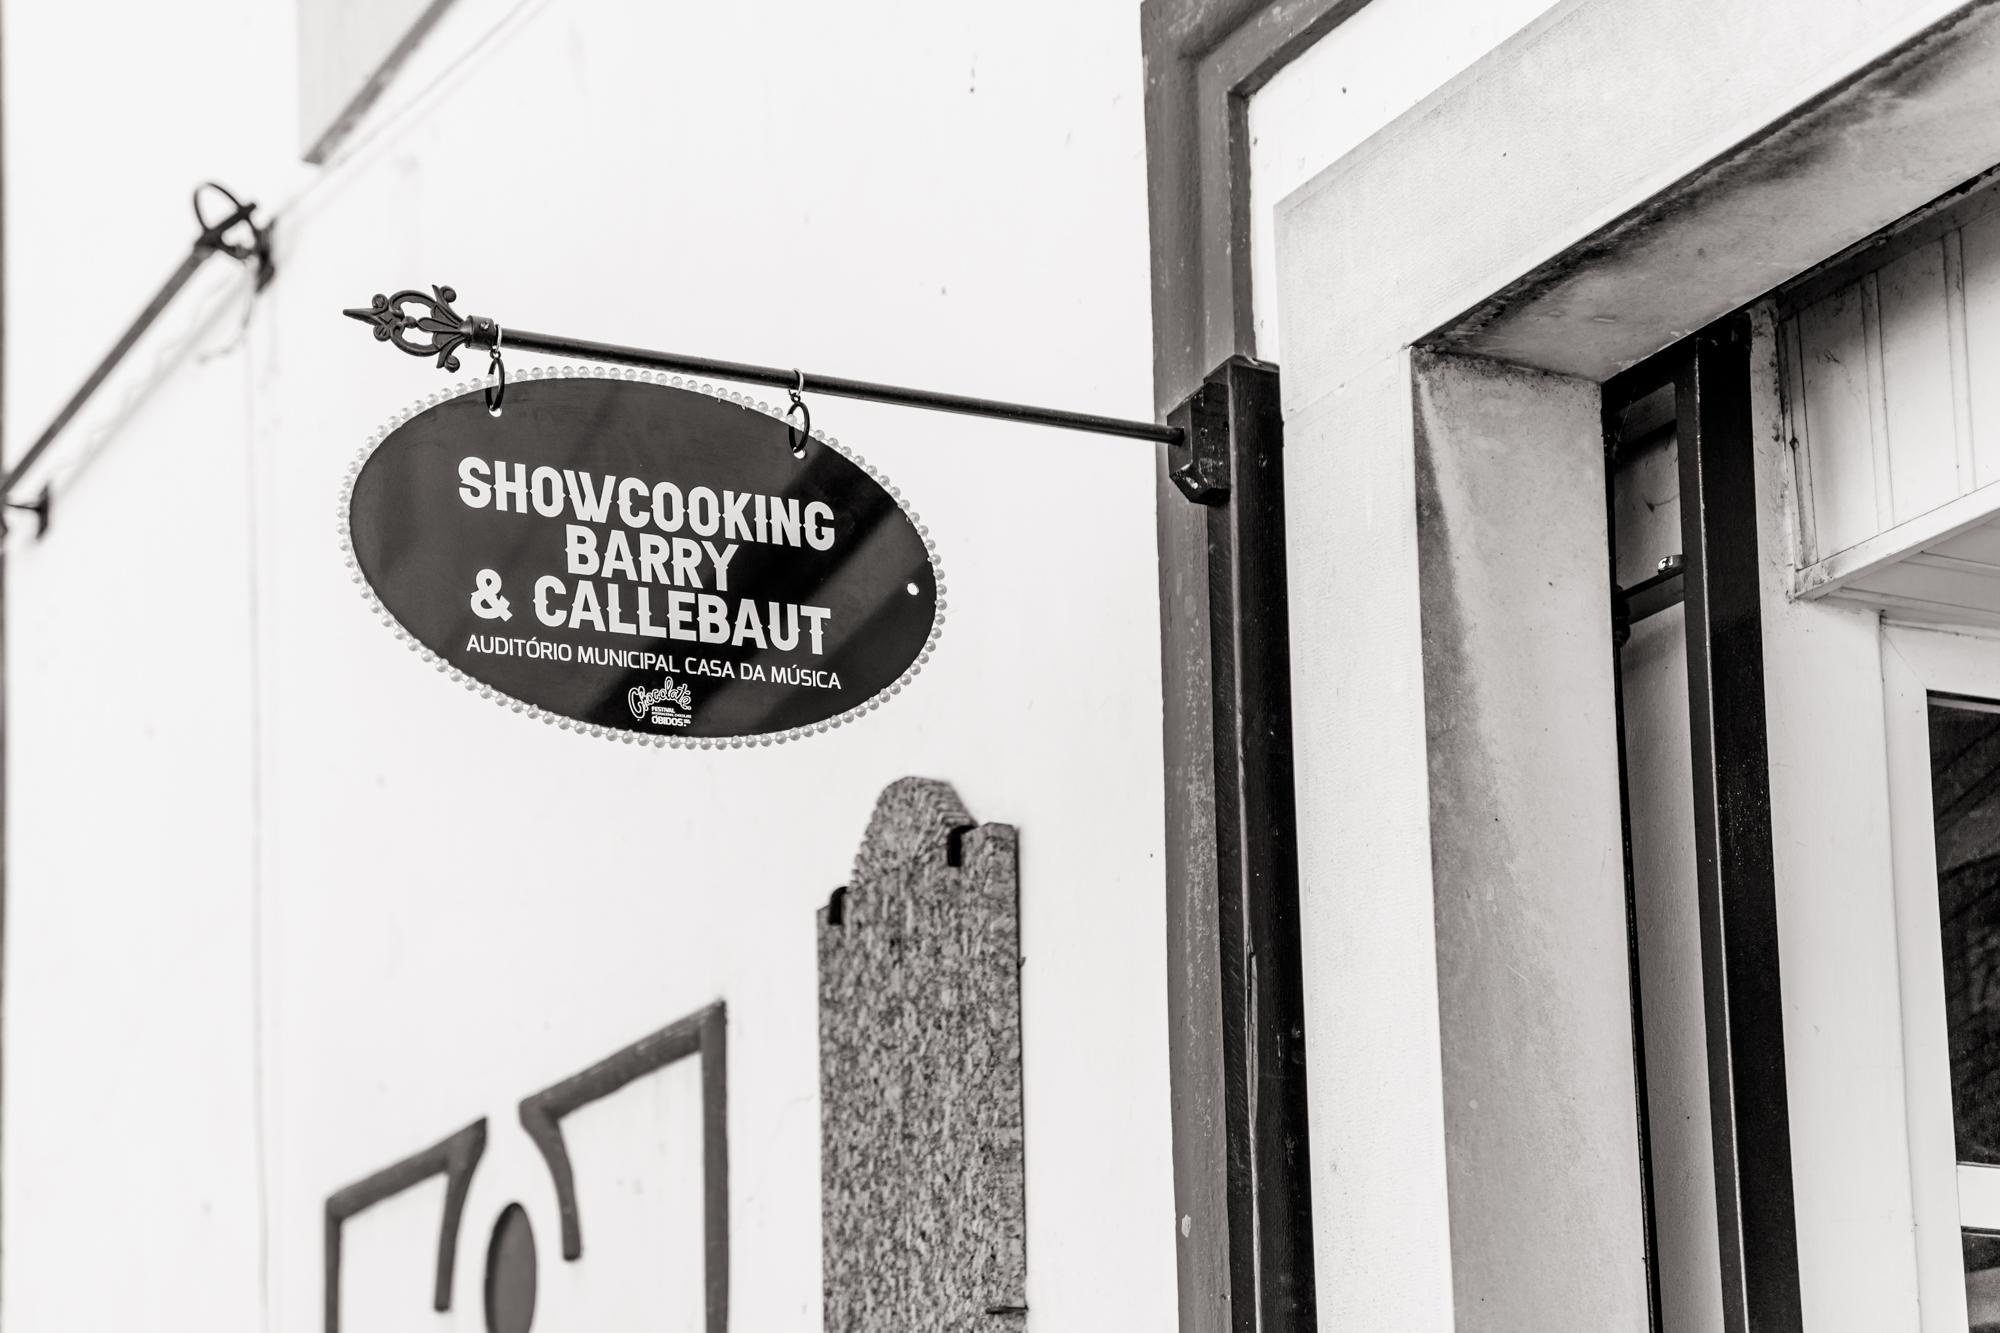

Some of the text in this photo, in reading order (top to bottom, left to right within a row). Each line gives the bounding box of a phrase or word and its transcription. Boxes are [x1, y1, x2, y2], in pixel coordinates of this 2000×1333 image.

[457, 456, 835, 551] SHOWCOOKING
[564, 523, 740, 592] BARRY
[470, 568, 832, 656] & CALLEBAUT
[465, 634, 842, 690] AUDITÓRIO MUNICIPAL CASA DA MÚSICA
